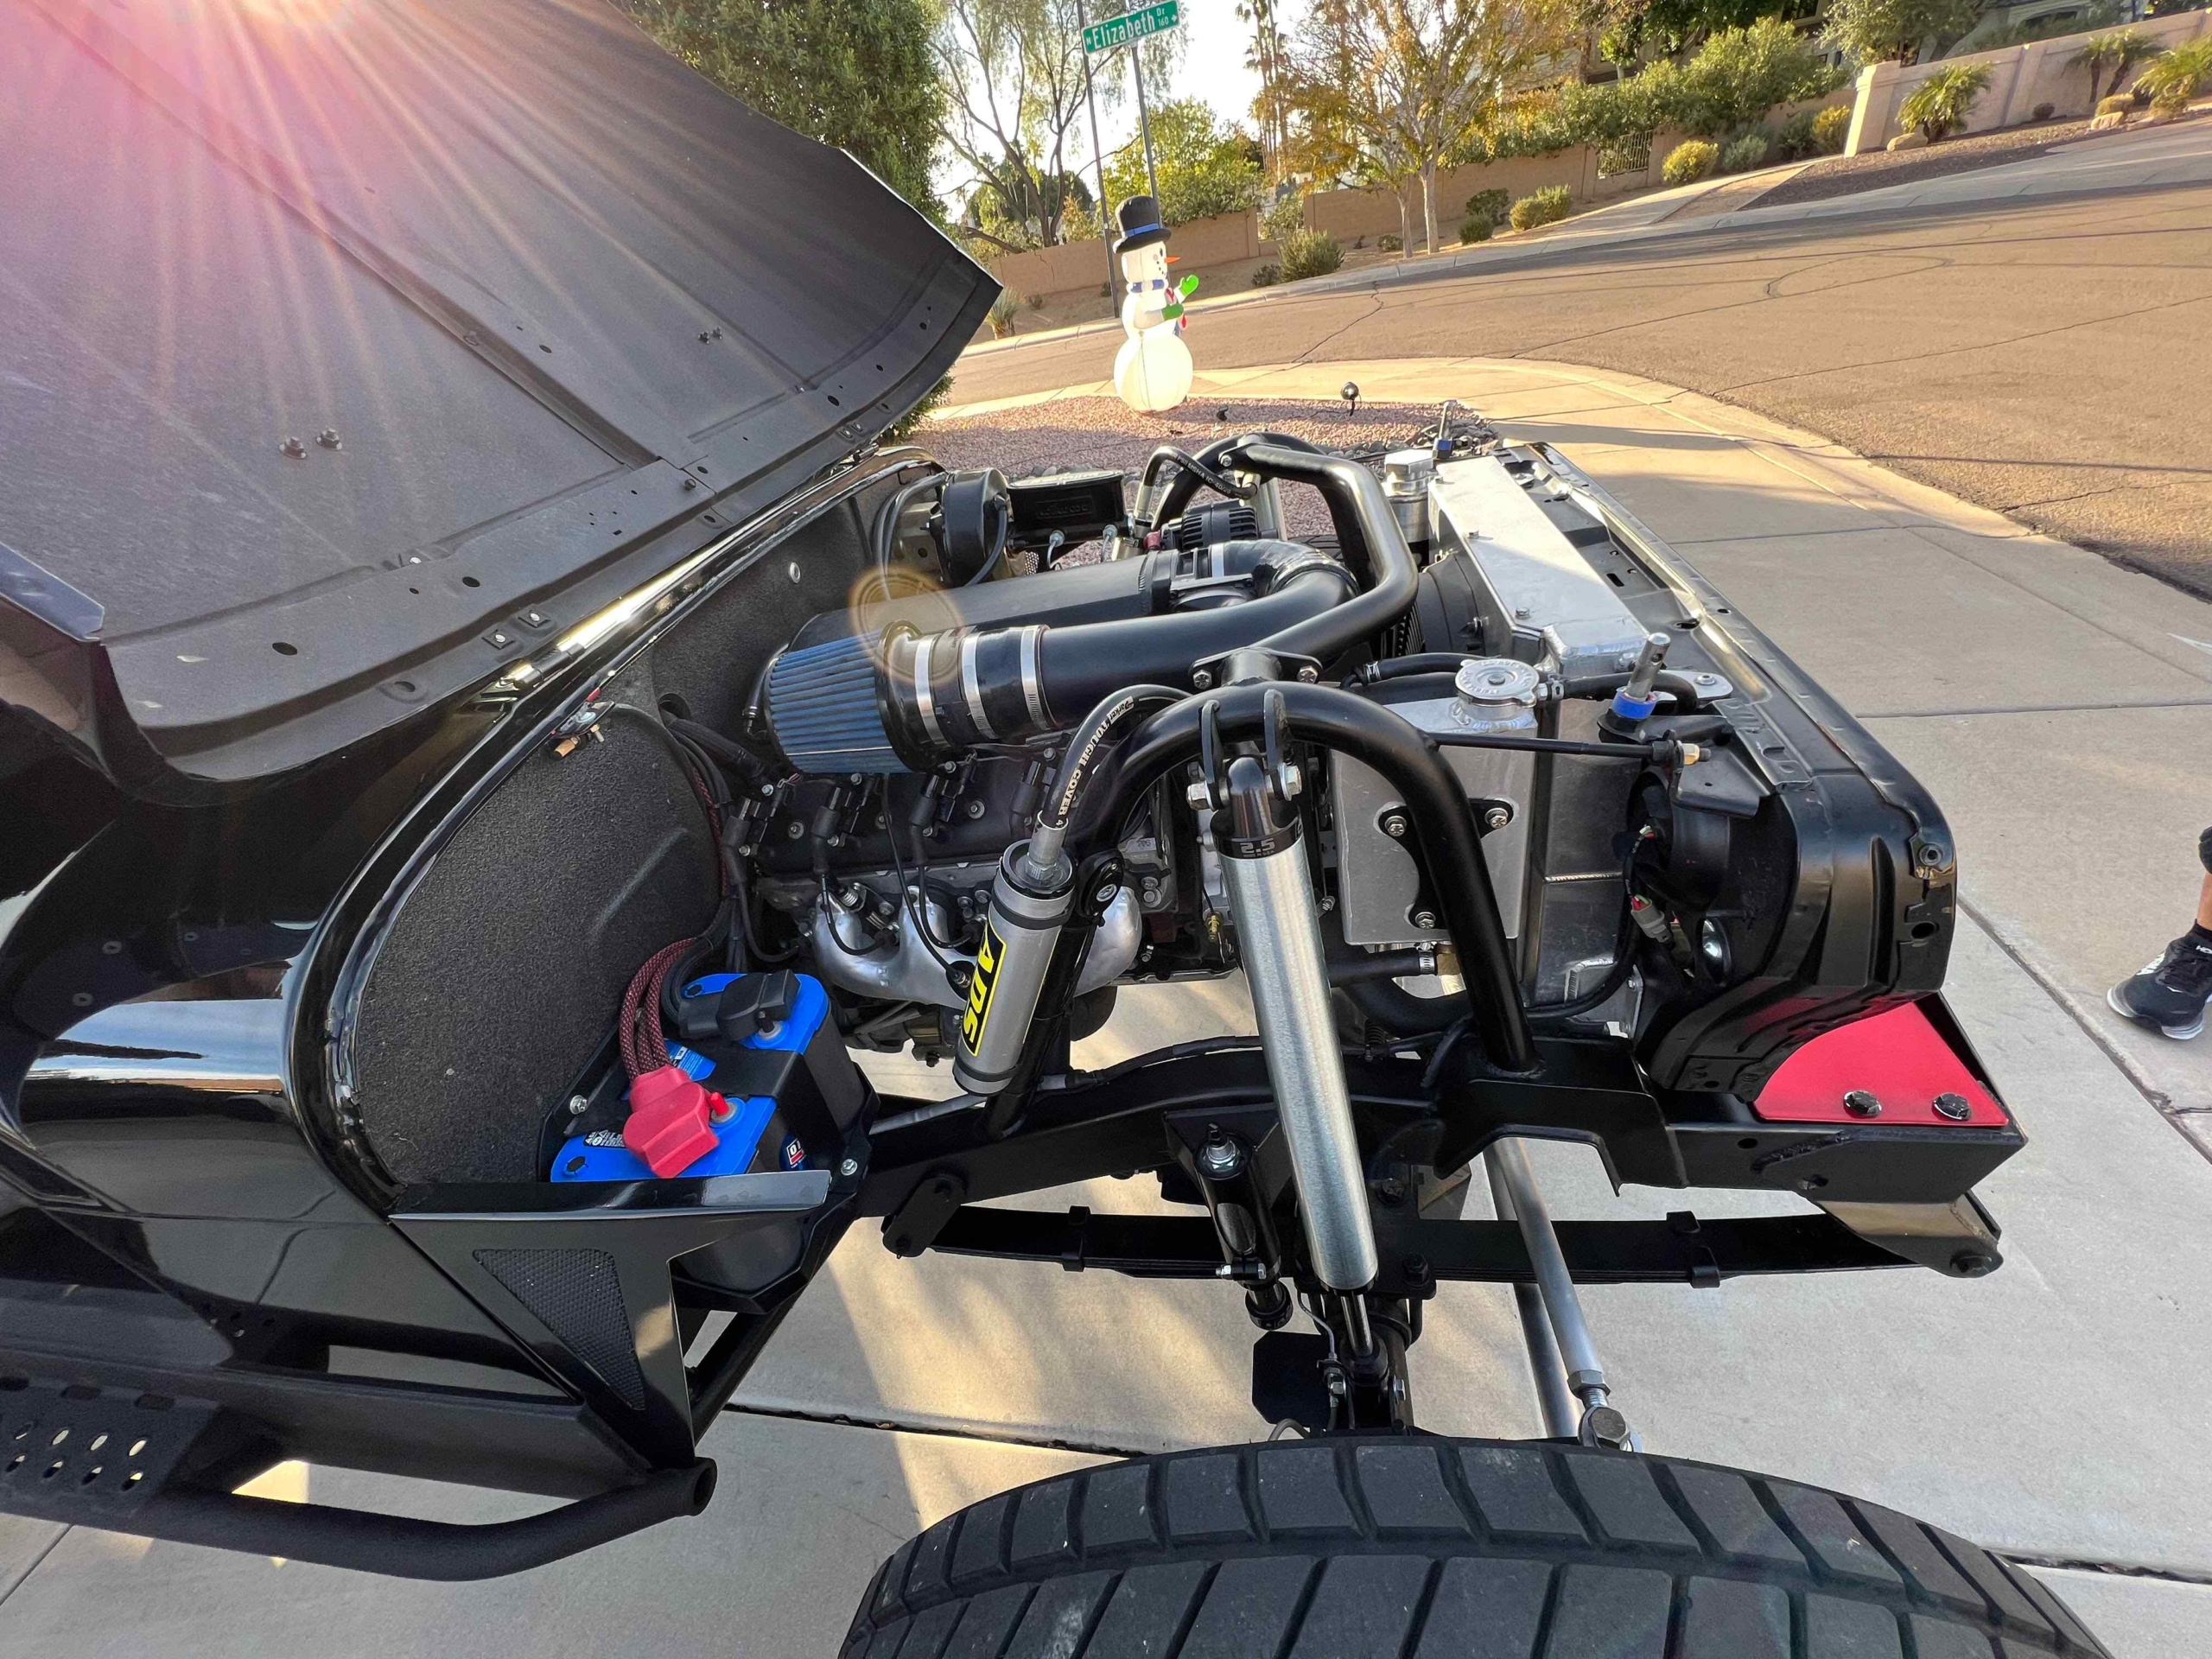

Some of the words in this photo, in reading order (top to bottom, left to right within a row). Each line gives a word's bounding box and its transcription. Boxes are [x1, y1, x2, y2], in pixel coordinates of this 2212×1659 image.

[1086, 36, 1091, 46] N
[1091, 11, 1155, 49] Elizabeth
[1156, 7, 1165, 16] Dr
[1158, 16, 1169, 27] 160
[1109, 700, 1135, 721] Parker
[1079, 720, 1110, 767] TOUGH
[1058, 768, 1082, 817] COVER
[1240, 837, 1275, 854] 2.5
[963, 939, 995, 1044] ADS
